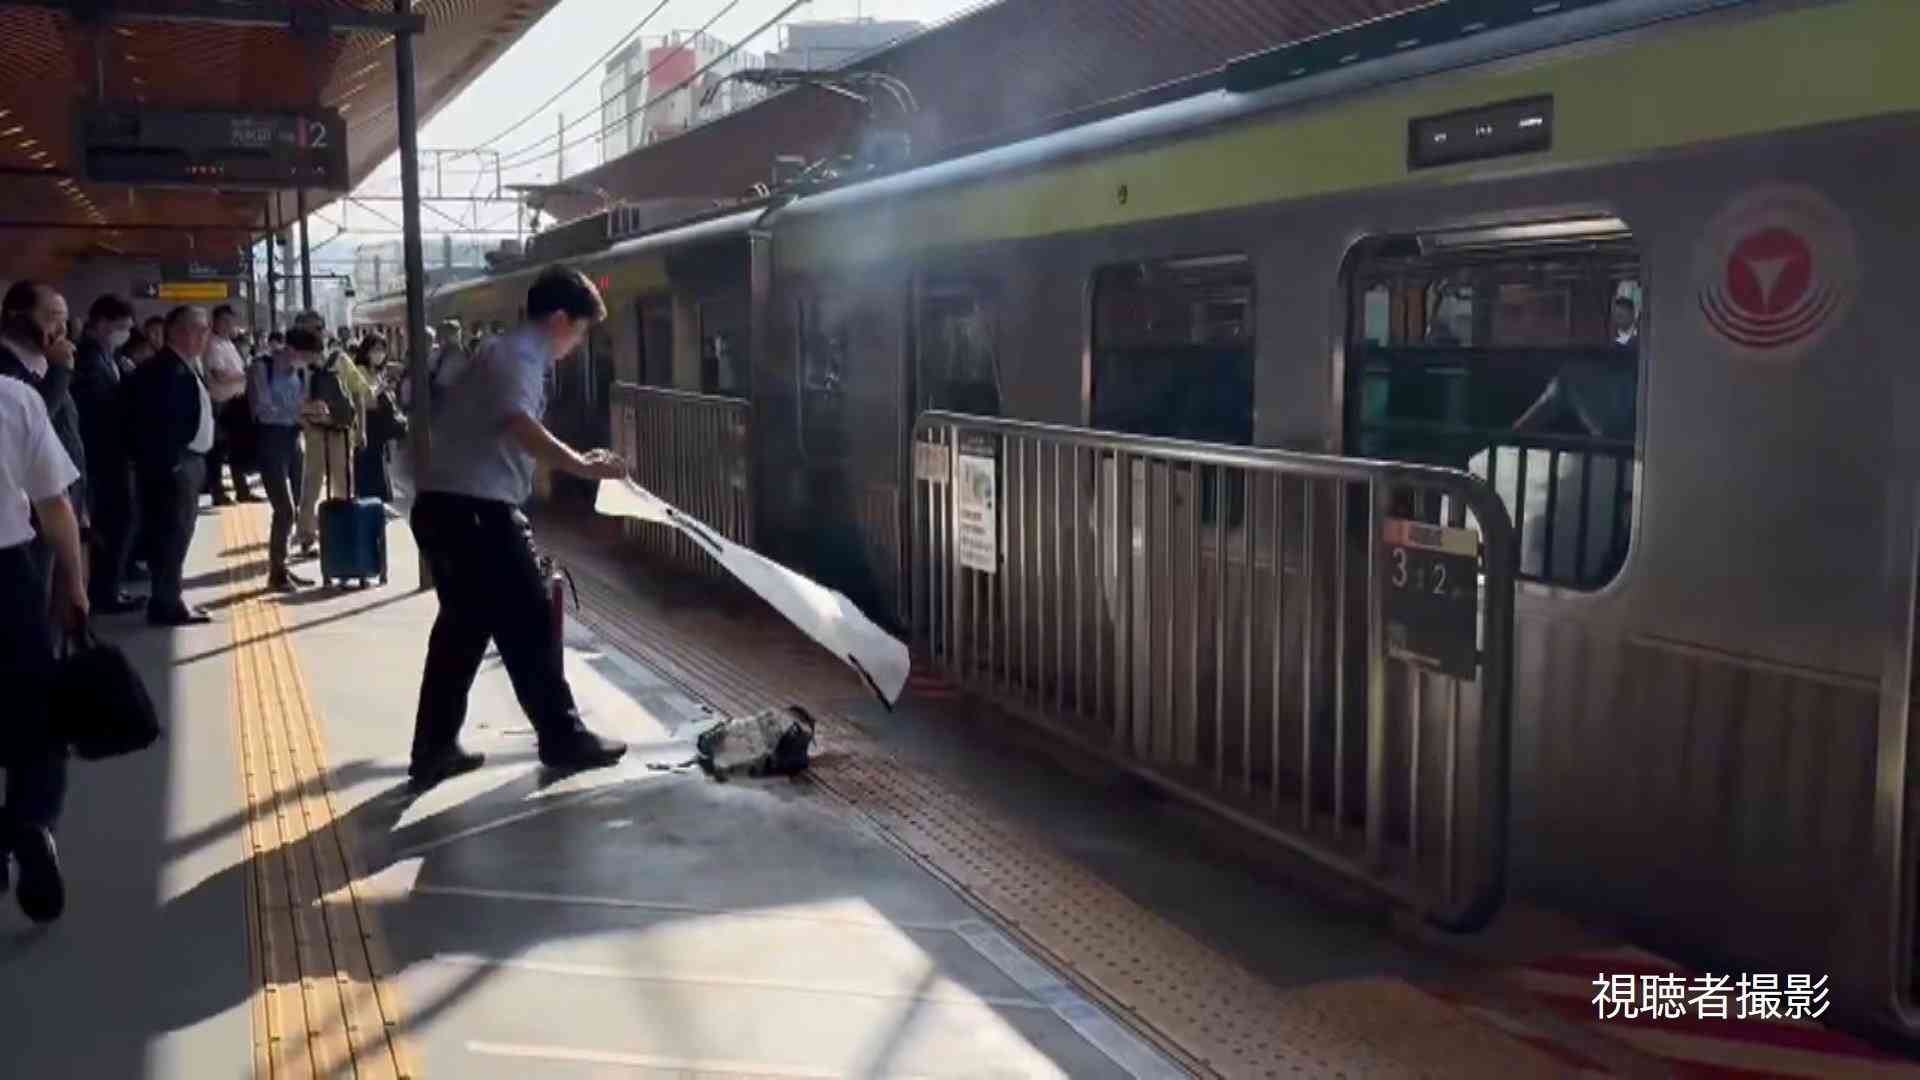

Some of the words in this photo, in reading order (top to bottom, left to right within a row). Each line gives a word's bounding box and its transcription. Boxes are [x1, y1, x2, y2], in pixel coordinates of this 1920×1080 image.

[310, 122, 328, 147] 2
[1391, 547, 1408, 588] 3
[1432, 564, 1447, 594] 2
